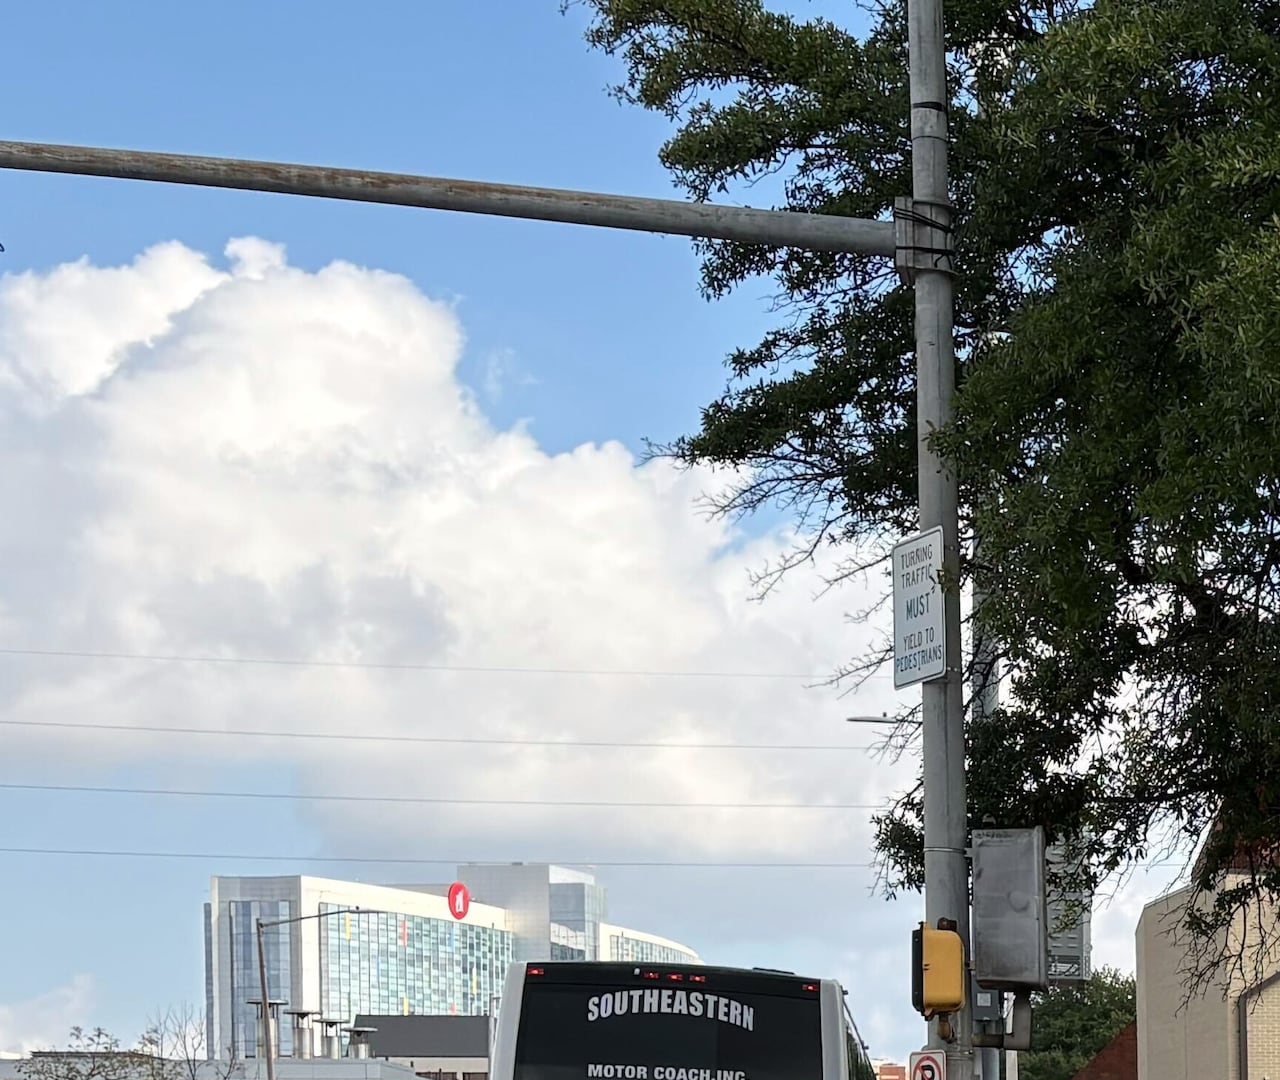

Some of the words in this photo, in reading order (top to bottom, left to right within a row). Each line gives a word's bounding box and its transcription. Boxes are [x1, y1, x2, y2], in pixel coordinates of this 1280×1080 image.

[901, 544, 932, 570] TURNING
[901, 563, 932, 589] TRAFFIC
[906, 592, 930, 620] MUST
[903, 631, 922, 652] YIELD
[925, 626, 935, 644] TO
[896, 644, 942, 672] PEDESTRIANS
[587, 988, 755, 1031] SOUTHEASTERN
[587, 1063, 648, 1080] MOTOR
